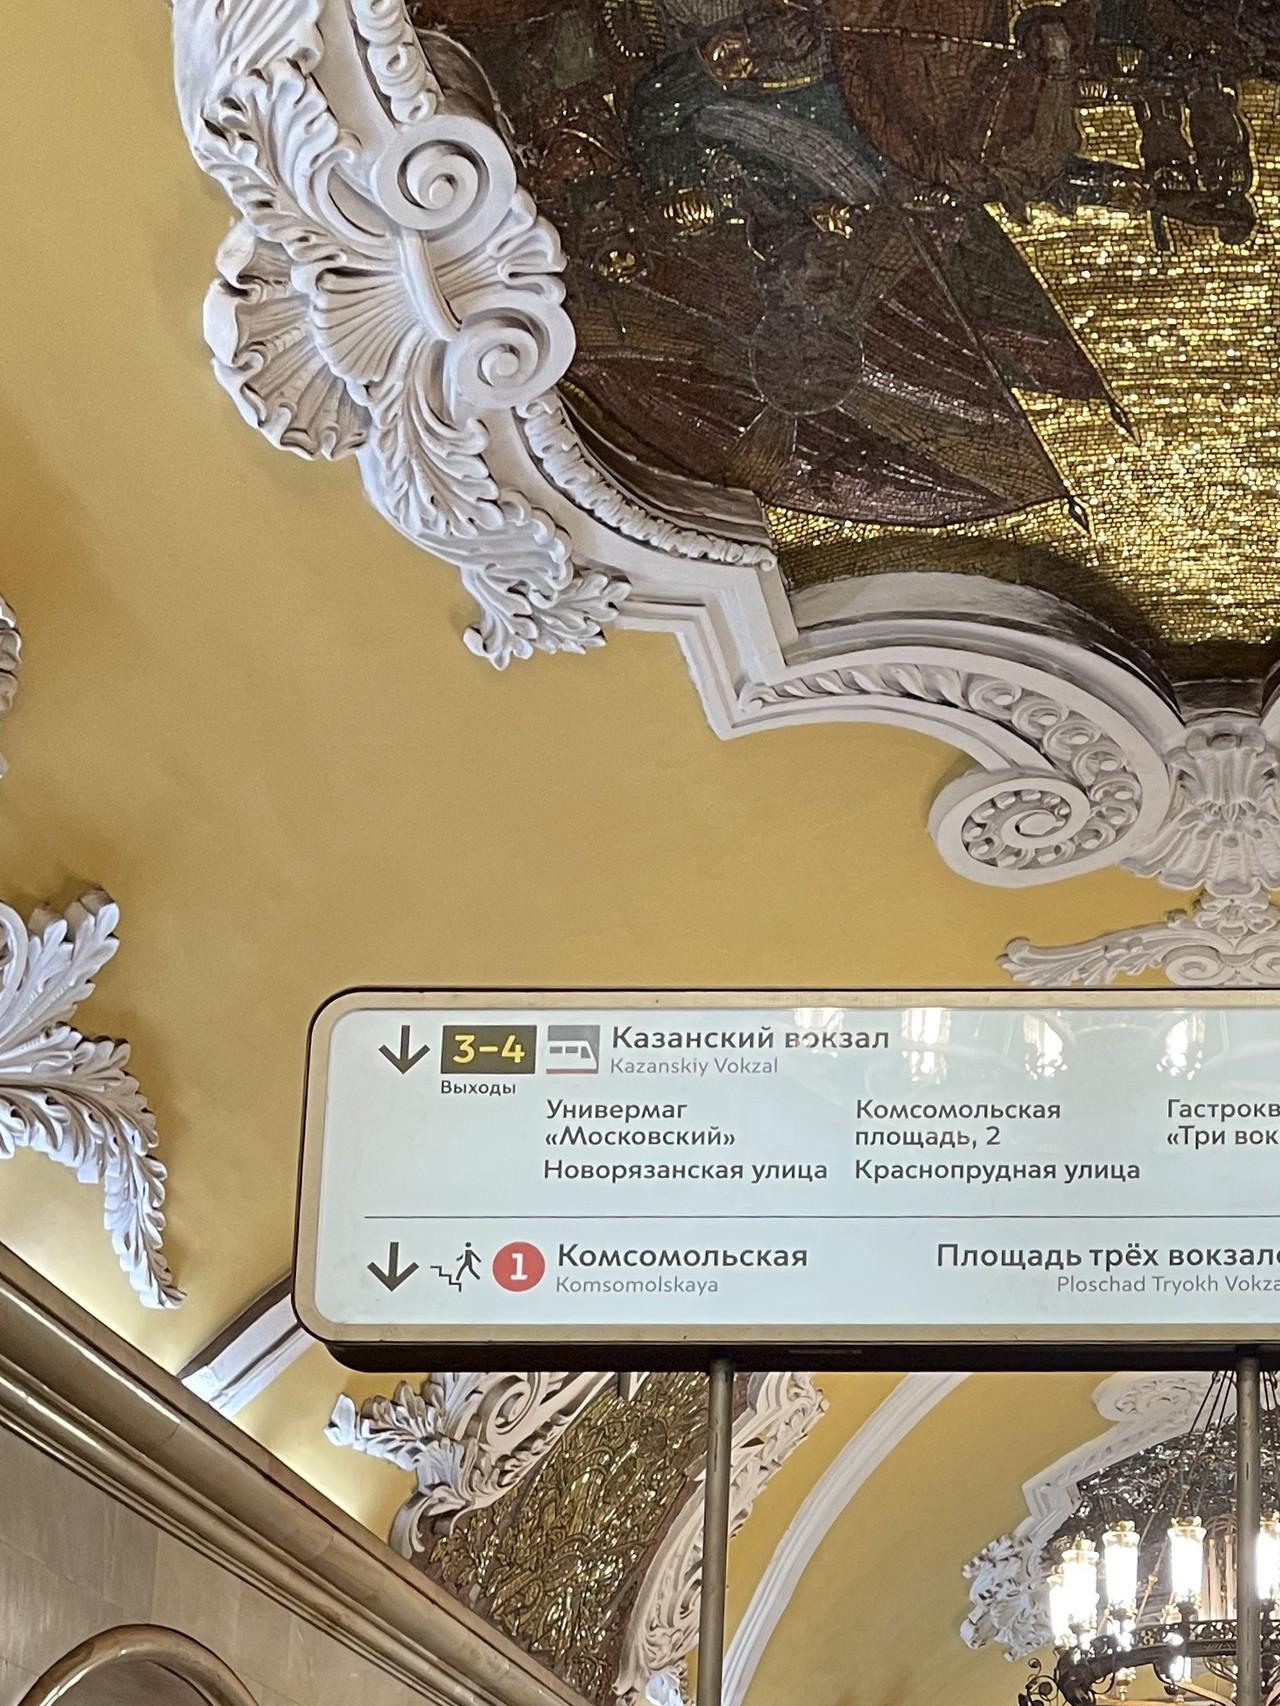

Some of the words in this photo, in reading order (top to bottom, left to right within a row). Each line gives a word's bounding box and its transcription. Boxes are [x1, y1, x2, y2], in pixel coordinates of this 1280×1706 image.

[613, 1025, 775, 1049] Казанский
[784, 1030, 890, 1050] вокзал
[610, 1057, 709, 1078] Kazanskiy
[713, 1056, 778, 1074] Vokzal
[440, 1079, 517, 1097] Выходы
[545, 1098, 689, 1124] Универмаг
[856, 1098, 1062, 1120] Комсомольская
[545, 1125, 736, 1147] «Московский»
[855, 1129, 977, 1151] площадь,
[985, 1125, 1001, 1146] 2
[1166, 1126, 1226, 1149] «Три
[543, 1158, 744, 1184] Новорязанская
[750, 1164, 828, 1184] улица
[855, 1158, 1057, 1185] Краснопрудная
[1063, 1163, 1141, 1185] улица
[510, 1252, 529, 1281] 1
[558, 1243, 808, 1268] Комсомольская
[937, 1243, 1083, 1271] Площадь
[1088, 1243, 1160, 1272] трёх
[556, 1275, 718, 1297] Komsomolskaya
[1057, 1273, 1146, 1293] Ploschad
[1151, 1274, 1219, 1296] Tryokh
